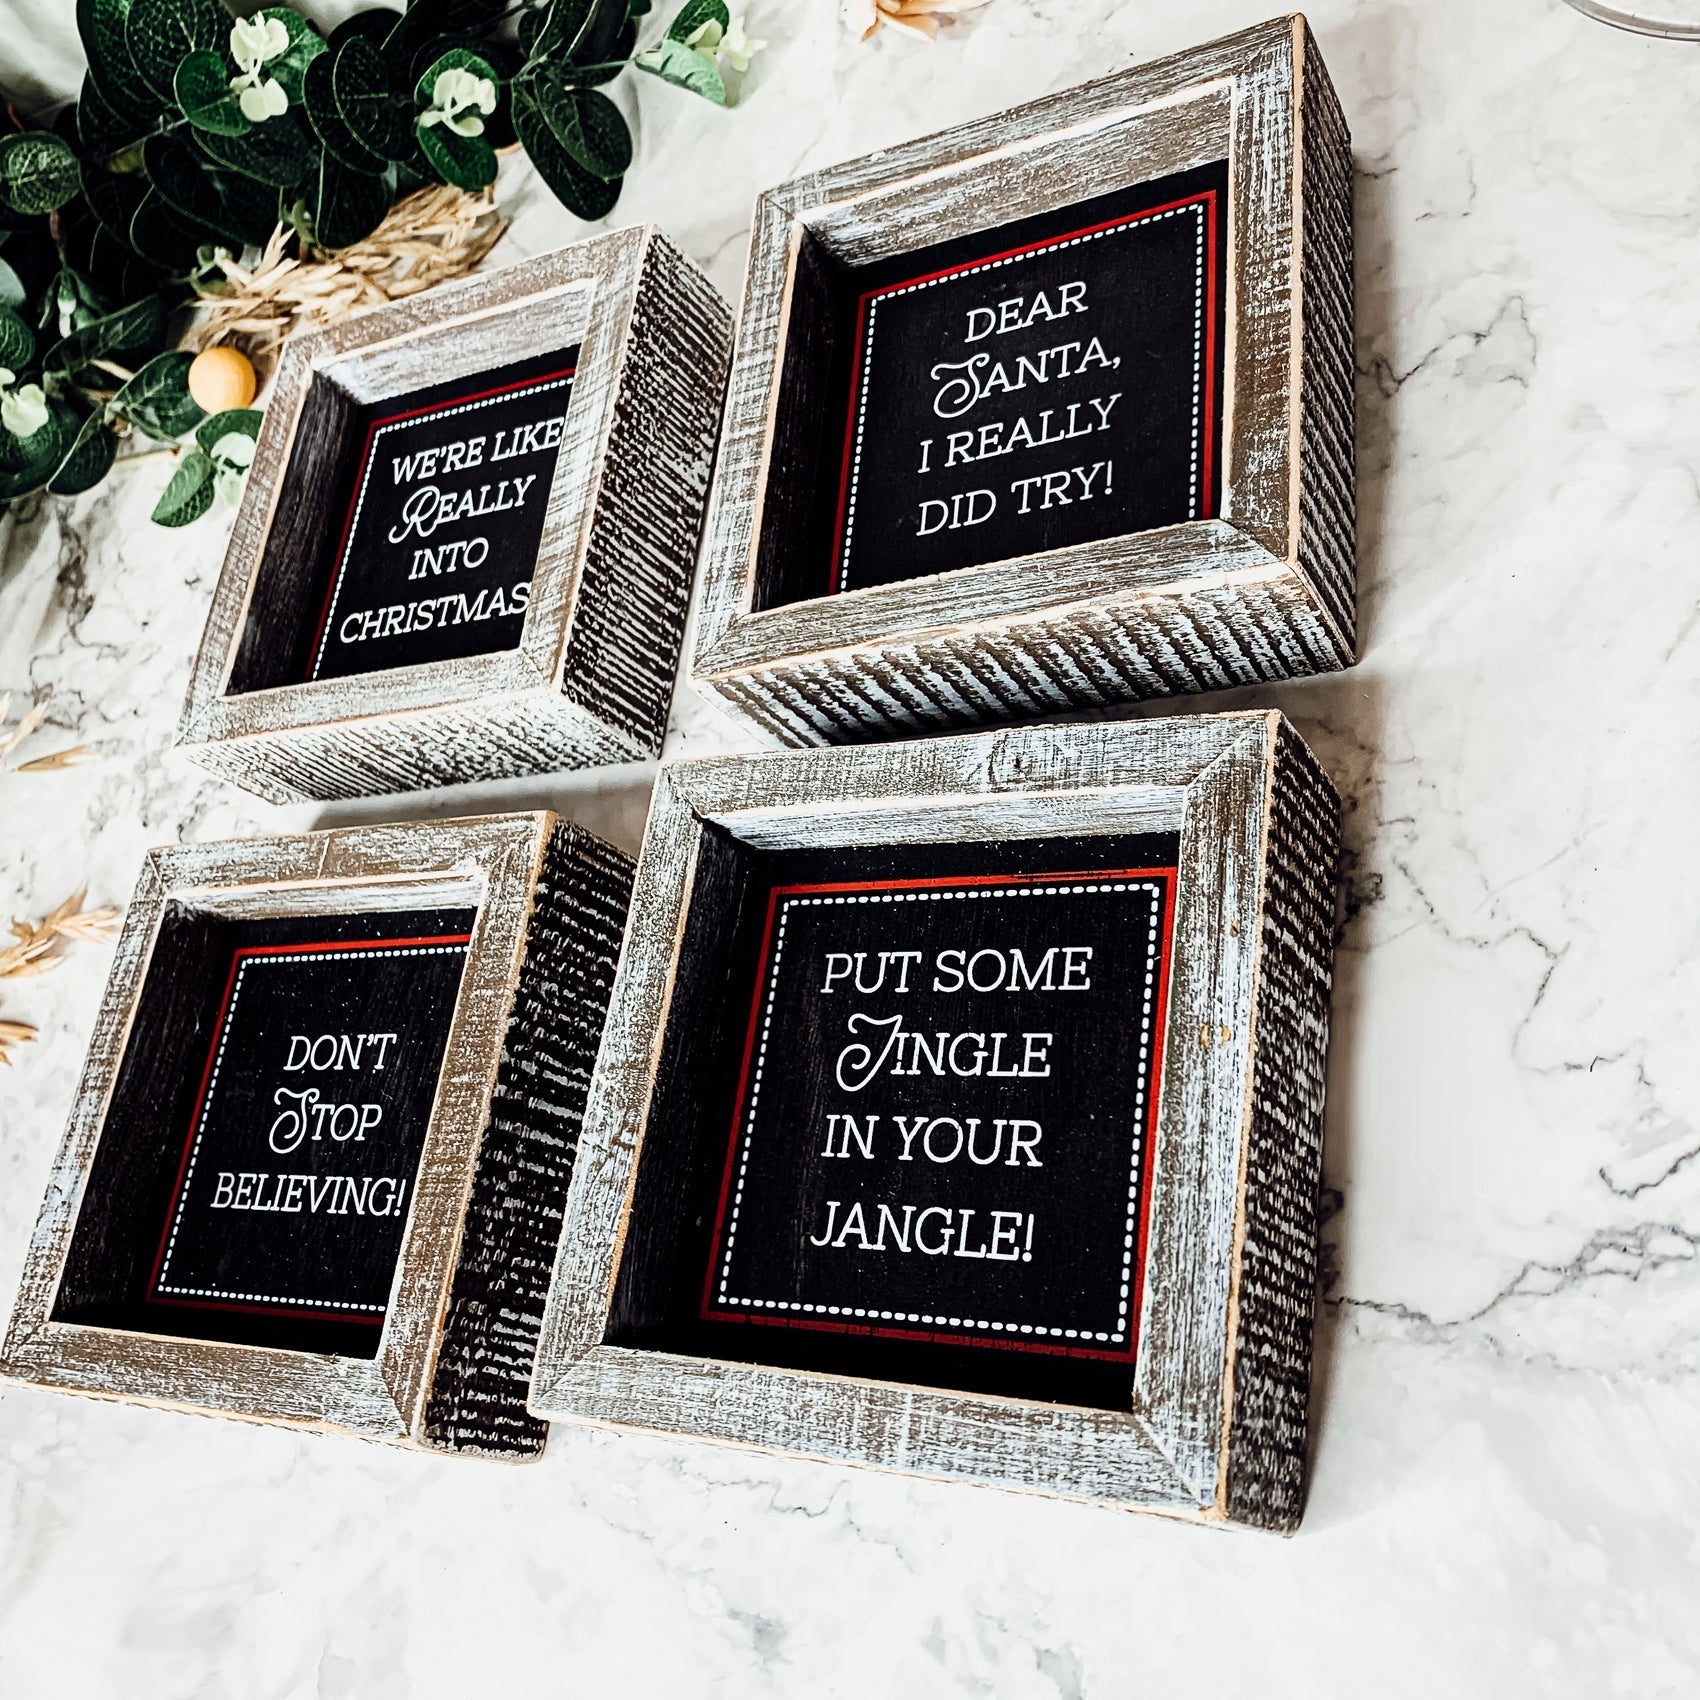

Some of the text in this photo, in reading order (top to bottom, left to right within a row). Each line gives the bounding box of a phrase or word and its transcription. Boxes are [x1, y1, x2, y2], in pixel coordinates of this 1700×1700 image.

[964, 281, 1088, 343] DEAR
[931, 337, 1121, 418] SANTA,
[392, 416, 565, 485] WE'RE LIKE
[917, 393, 1122, 473] I REALLY
[388, 474, 536, 544] REALLY
[916, 460, 1113, 536] DID TRY!
[408, 537, 489, 580] INTO
[340, 582, 531, 643] CHRISTMAS
[820, 947, 1093, 994] PUT SOME
[283, 1034, 397, 1071] DON'T
[836, 1013, 1053, 1092] JINGLE
[269, 1087, 383, 1154] STOP
[821, 1114, 1043, 1167] IN YOUR
[210, 1172, 406, 1217] BELIEVING!
[810, 1201, 1035, 1262] JANGLE!
